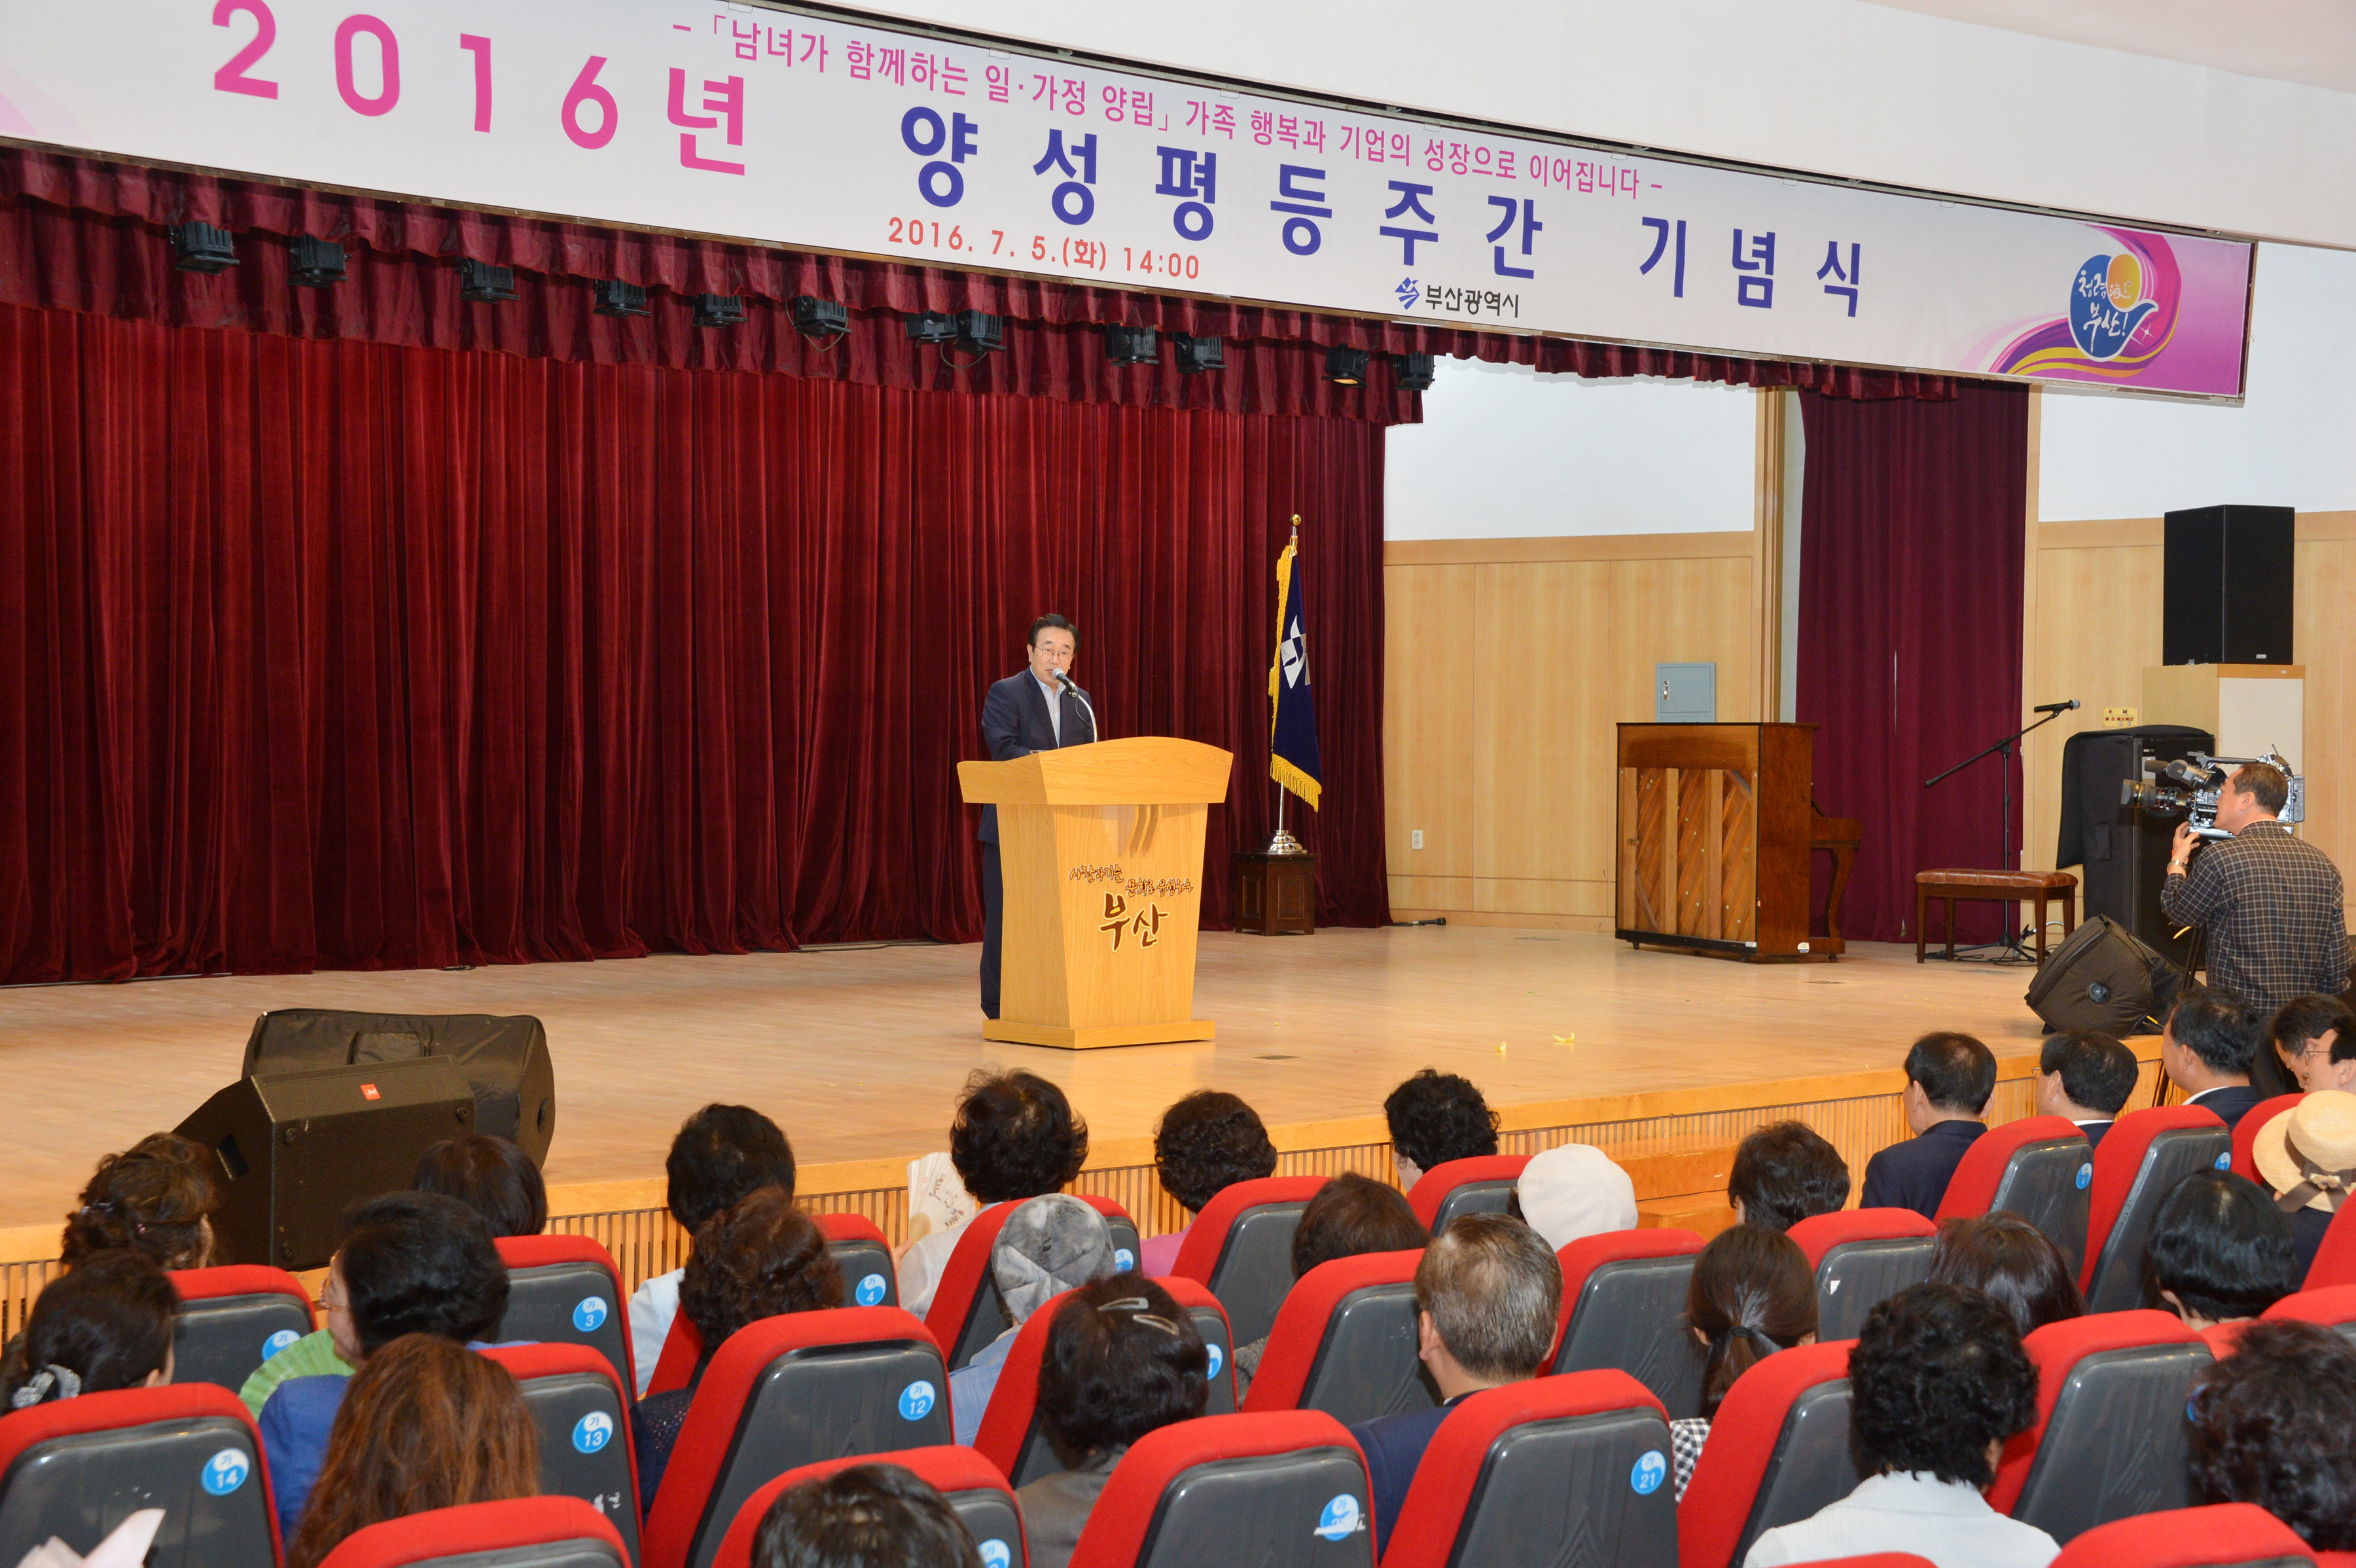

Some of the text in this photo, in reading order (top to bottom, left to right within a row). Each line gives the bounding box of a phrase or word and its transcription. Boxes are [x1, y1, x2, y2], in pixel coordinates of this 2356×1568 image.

[846, 40, 969, 96] 함께하는
[1186, 100, 1236, 140] 가족
[1251, 110, 1327, 154] 행복과
[1340, 126, 1410, 167] 기업의
[1424, 139, 1516, 179] 성장으로
[1530, 155, 1639, 197] 이어집니다
[889, 217, 973, 252] 2016.
[1124, 247, 1199, 279] 14:00
[1640, 217, 1861, 317] 기념식
[1425, 285, 1518, 318] 부산광역시
[1099, 892, 1169, 952] 부산
[866, 1291, 874, 1302] 4
[585, 1314, 594, 1327] 3
[910, 1400, 926, 1415] 12
[585, 1431, 603, 1447] 13
[217, 1469, 239, 1489] 14
[1639, 1472, 1656, 1489] 21
